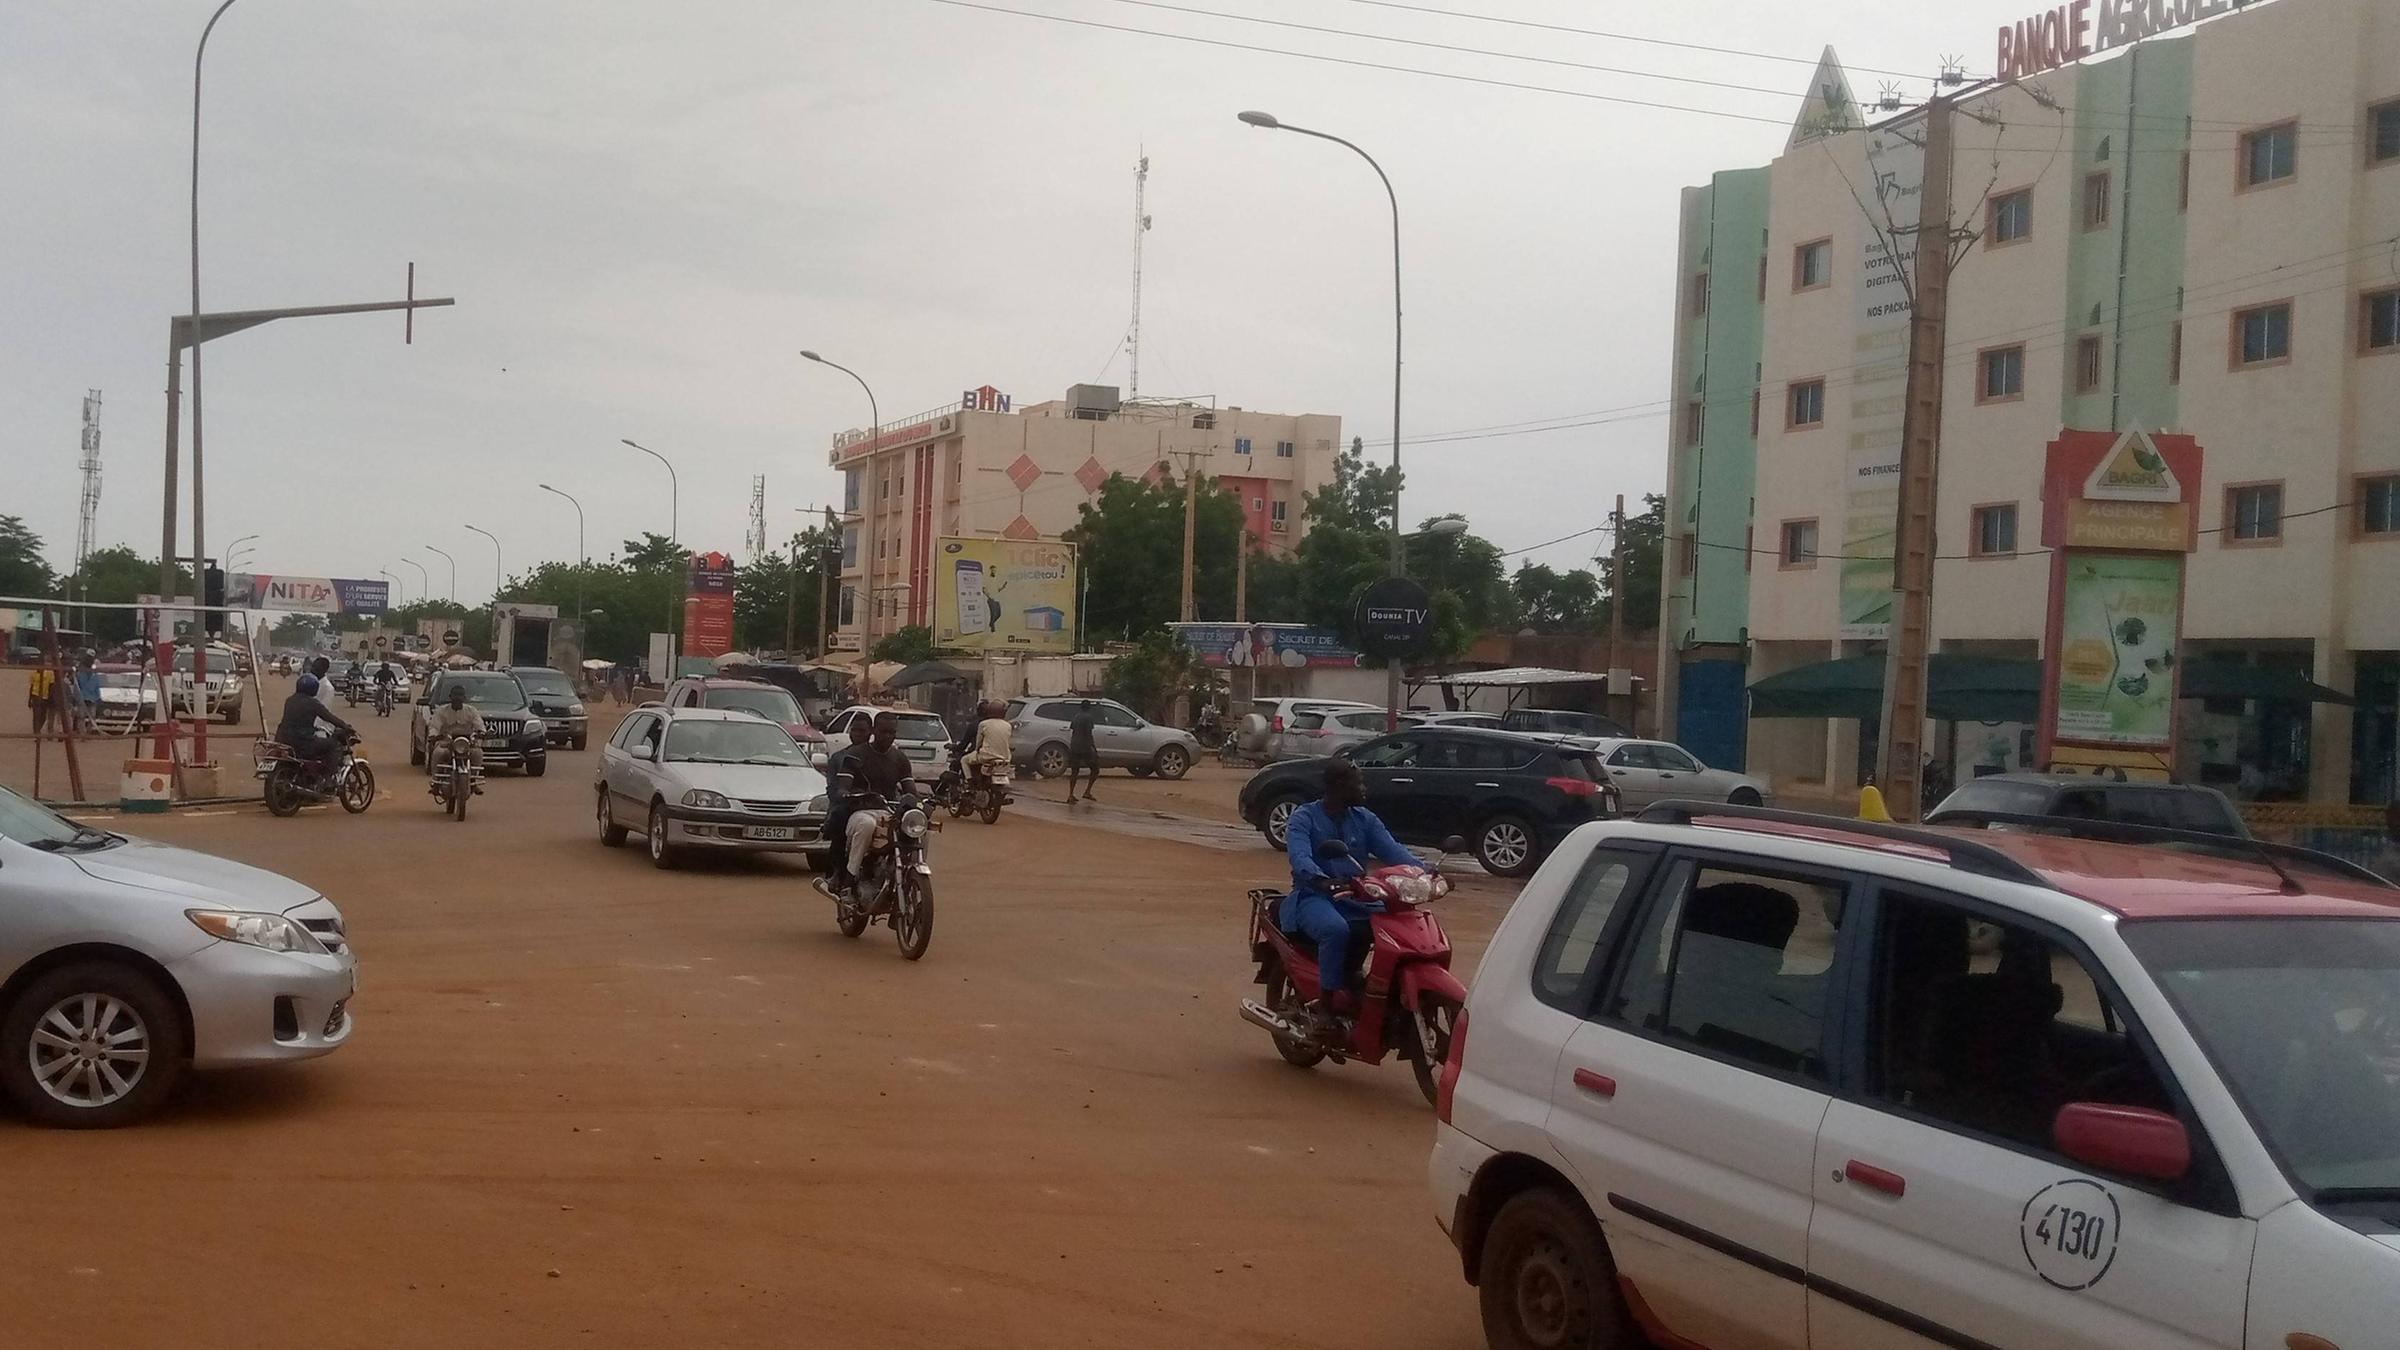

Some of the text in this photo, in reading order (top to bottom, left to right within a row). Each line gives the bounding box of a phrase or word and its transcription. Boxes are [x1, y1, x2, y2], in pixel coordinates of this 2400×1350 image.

[1997, 0, 2091, 82] BANQUE
[1884, 301, 1911, 315] PACKA
[1873, 463, 1901, 474] FINANCE
[2108, 471, 2157, 484] BAGRI
[2087, 503, 2163, 519] AGENCE
[2074, 523, 2180, 542] PRINCIPALE
[271, 582, 325, 600] NITA
[1371, 608, 1428, 624] DOUNIA TV
[2036, 1203, 2105, 1261] 4130
